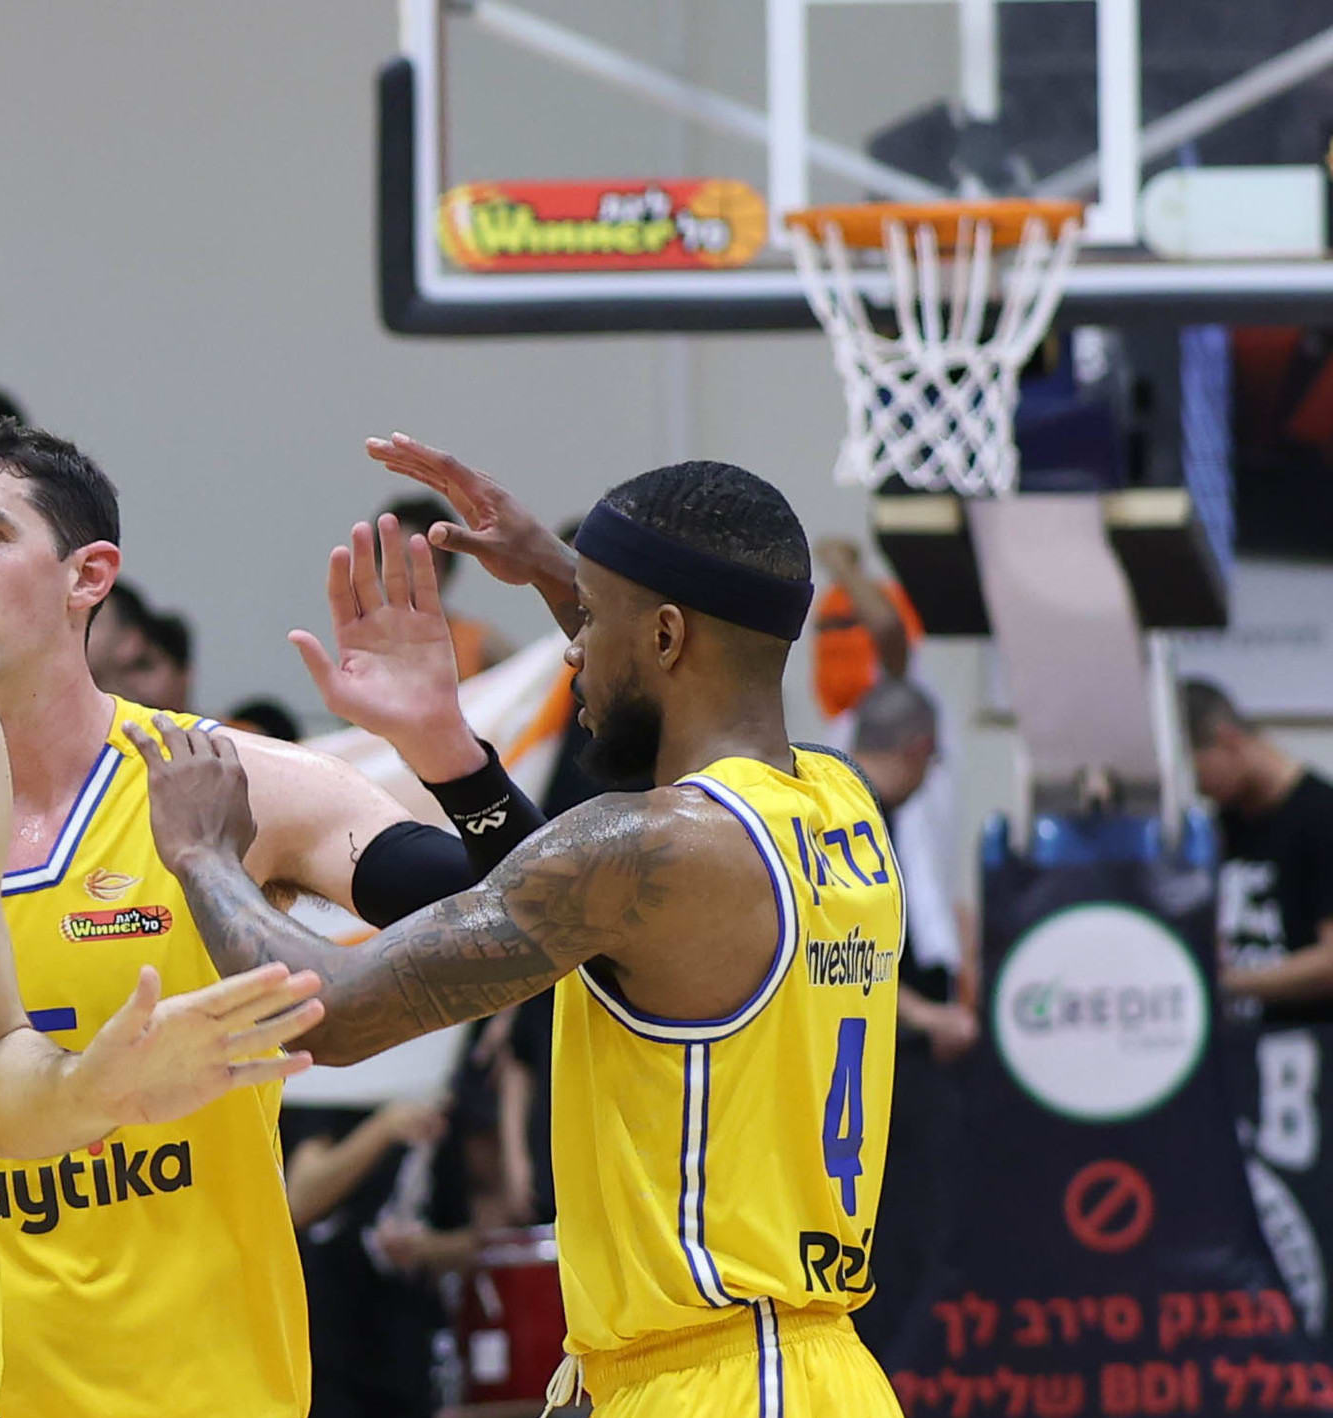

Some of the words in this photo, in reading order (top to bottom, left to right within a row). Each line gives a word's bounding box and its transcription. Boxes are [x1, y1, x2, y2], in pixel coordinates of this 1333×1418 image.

[475, 202, 675, 254] Winner
[72, 918, 141, 936] Winner
[142, 917, 159, 931] סל
[822, 1017, 867, 1217] 4
